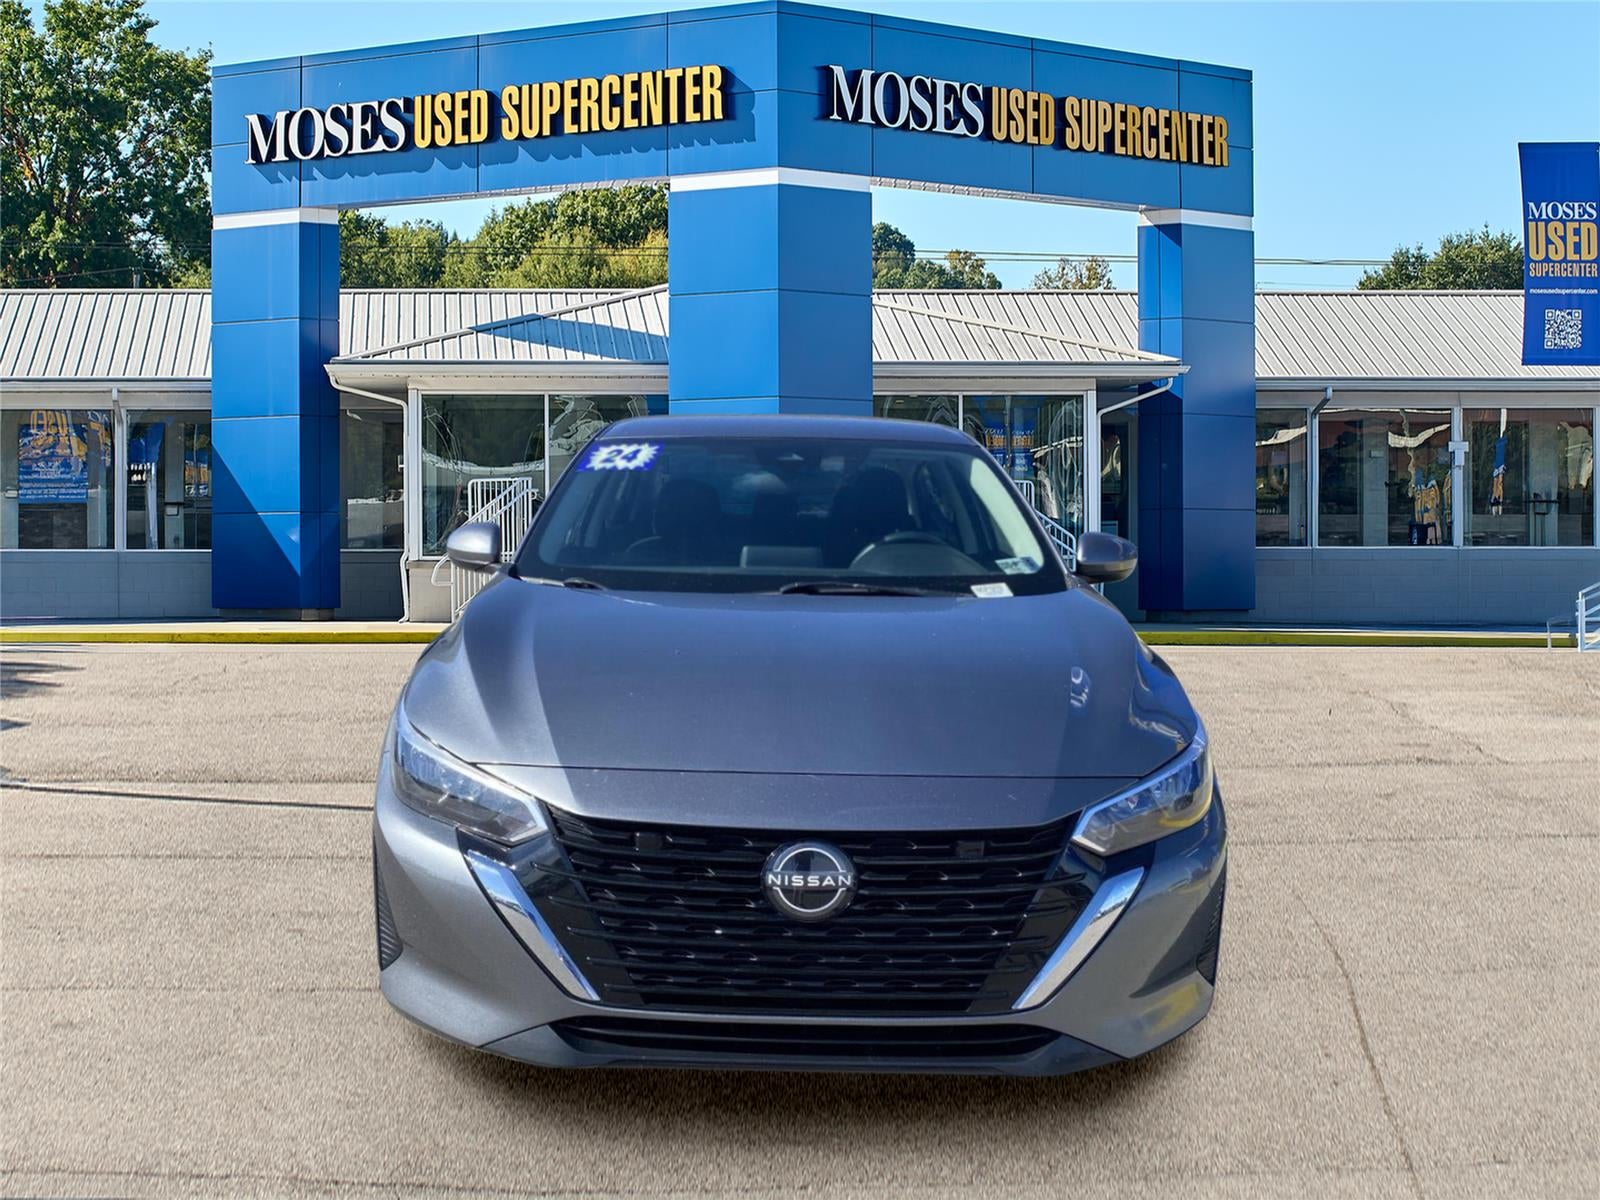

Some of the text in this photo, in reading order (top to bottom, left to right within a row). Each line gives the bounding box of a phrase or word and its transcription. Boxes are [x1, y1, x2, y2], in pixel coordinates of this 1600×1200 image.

[244, 63, 726, 165] MOSES USED SUPERCENTER
[828, 64, 1229, 167] MOSES USED SUPERCENTER
[1527, 201, 1598, 220] MOSES
[1528, 221, 1598, 261] USED
[1529, 262, 1598, 278] SUPERCENTER
[599, 448, 642, 463] 24
[768, 873, 852, 887] NISSAN
